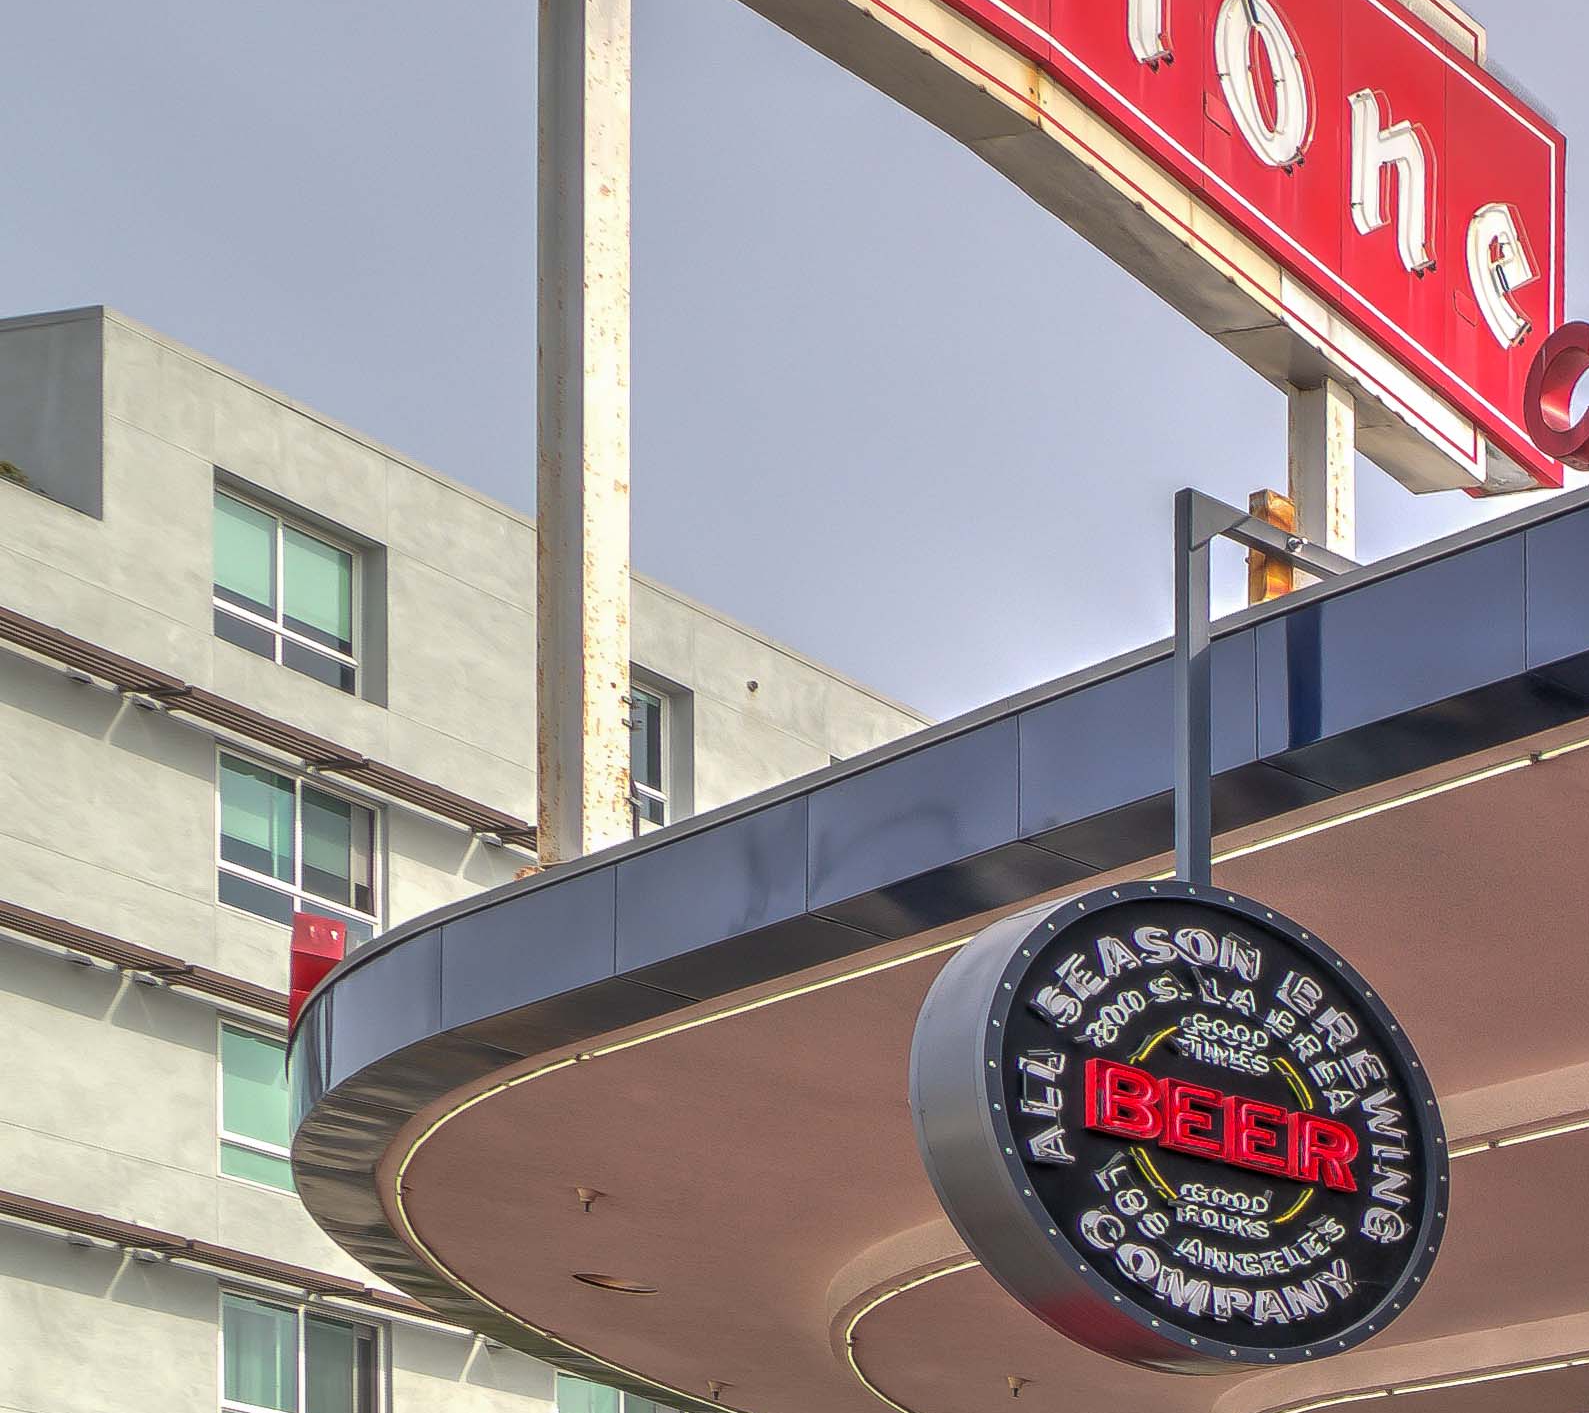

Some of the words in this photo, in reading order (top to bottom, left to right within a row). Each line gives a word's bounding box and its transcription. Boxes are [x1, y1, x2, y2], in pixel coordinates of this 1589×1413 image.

[1029, 926, 1263, 1028] SEASON
[1179, 1014, 1270, 1049] GOOD
[1017, 1049, 1076, 1164] ALL
[1084, 1058, 1358, 1192] BEER
[1276, 971, 1412, 1244] BREWING
[1174, 1216, 1347, 1277] ANGELES
[1178, 1182, 1271, 1214] GOOD
[1080, 1208, 1358, 1325] COMPANY
